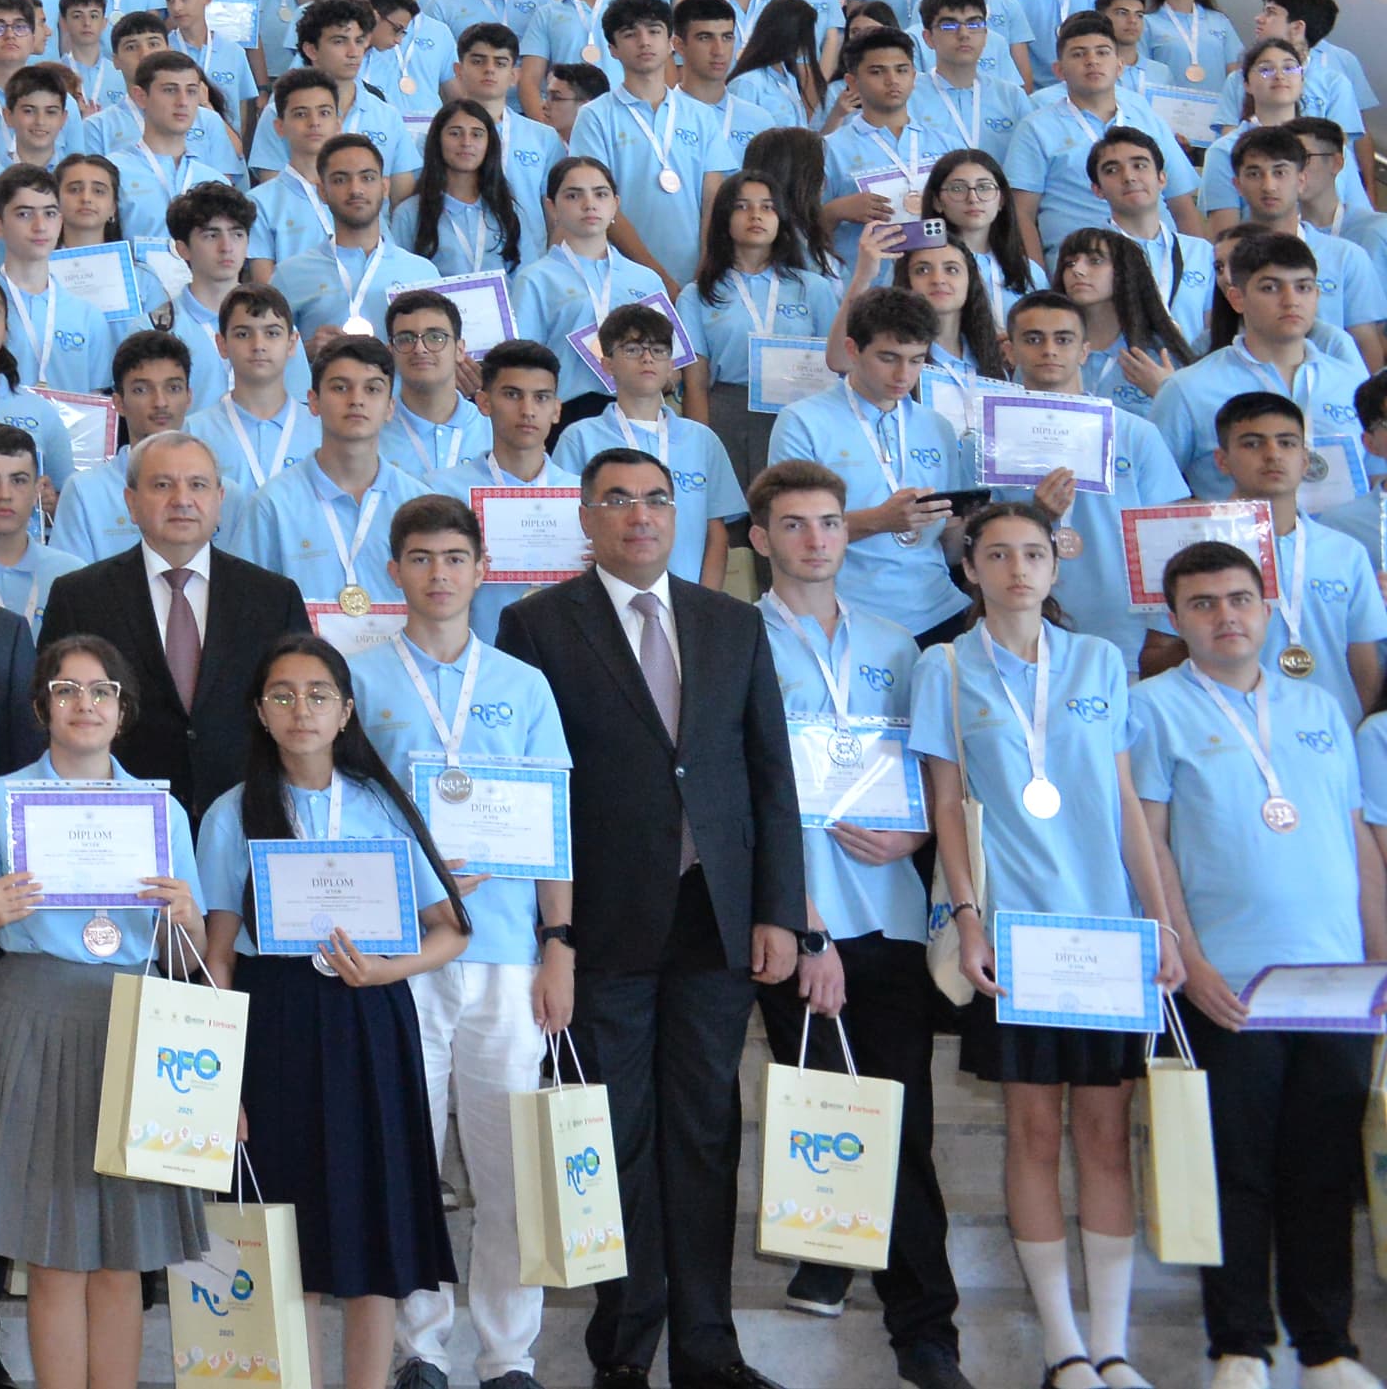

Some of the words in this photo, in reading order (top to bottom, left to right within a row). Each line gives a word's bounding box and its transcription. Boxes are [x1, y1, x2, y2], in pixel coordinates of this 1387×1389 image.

[514, 150, 539, 167] RFO
[55, 331, 86, 349] RFO
[4, 417, 38, 429] RFO
[1323, 403, 1357, 423] RFO
[1032, 427, 1069, 436] DİPLOM
[910, 448, 941, 469] RFO
[673, 470, 706, 492] RFO
[521, 517, 557, 528] DİPLOM
[1311, 580, 1347, 603] RFO
[860, 665, 895, 692] RFO
[470, 702, 513, 729] RFO
[1065, 697, 1108, 723] RFO
[471, 802, 512, 813] DİPLOM
[68, 829, 112, 840] DİPLOM
[312, 876, 354, 888] DİPLOM
[1055, 950, 1098, 964] DİPLOM
[157, 1046, 221, 1094] RFO
[790, 1130, 864, 1174] RFO
[566, 1147, 600, 1196] RFO
